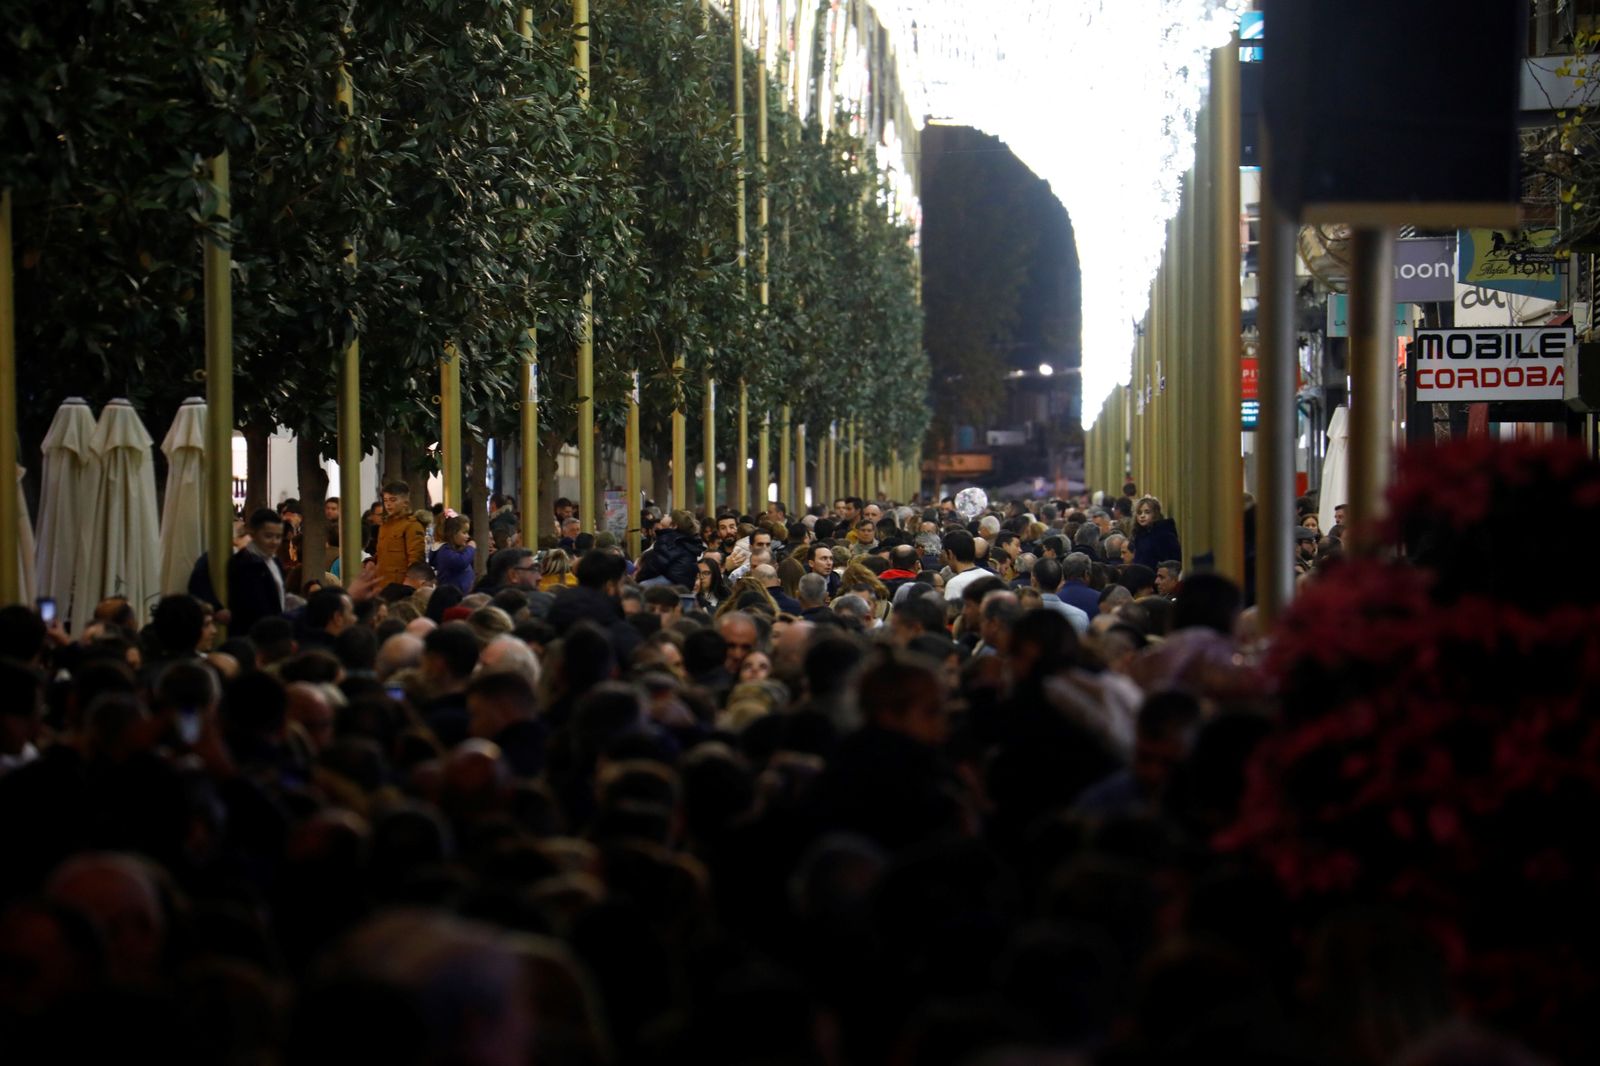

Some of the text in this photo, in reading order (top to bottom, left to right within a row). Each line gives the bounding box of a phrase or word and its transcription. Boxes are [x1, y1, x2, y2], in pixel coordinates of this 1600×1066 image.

[1393, 262, 1458, 279] oon
[1417, 333, 1566, 359] MOBILE
[1415, 365, 1564, 389] CORDOBA
